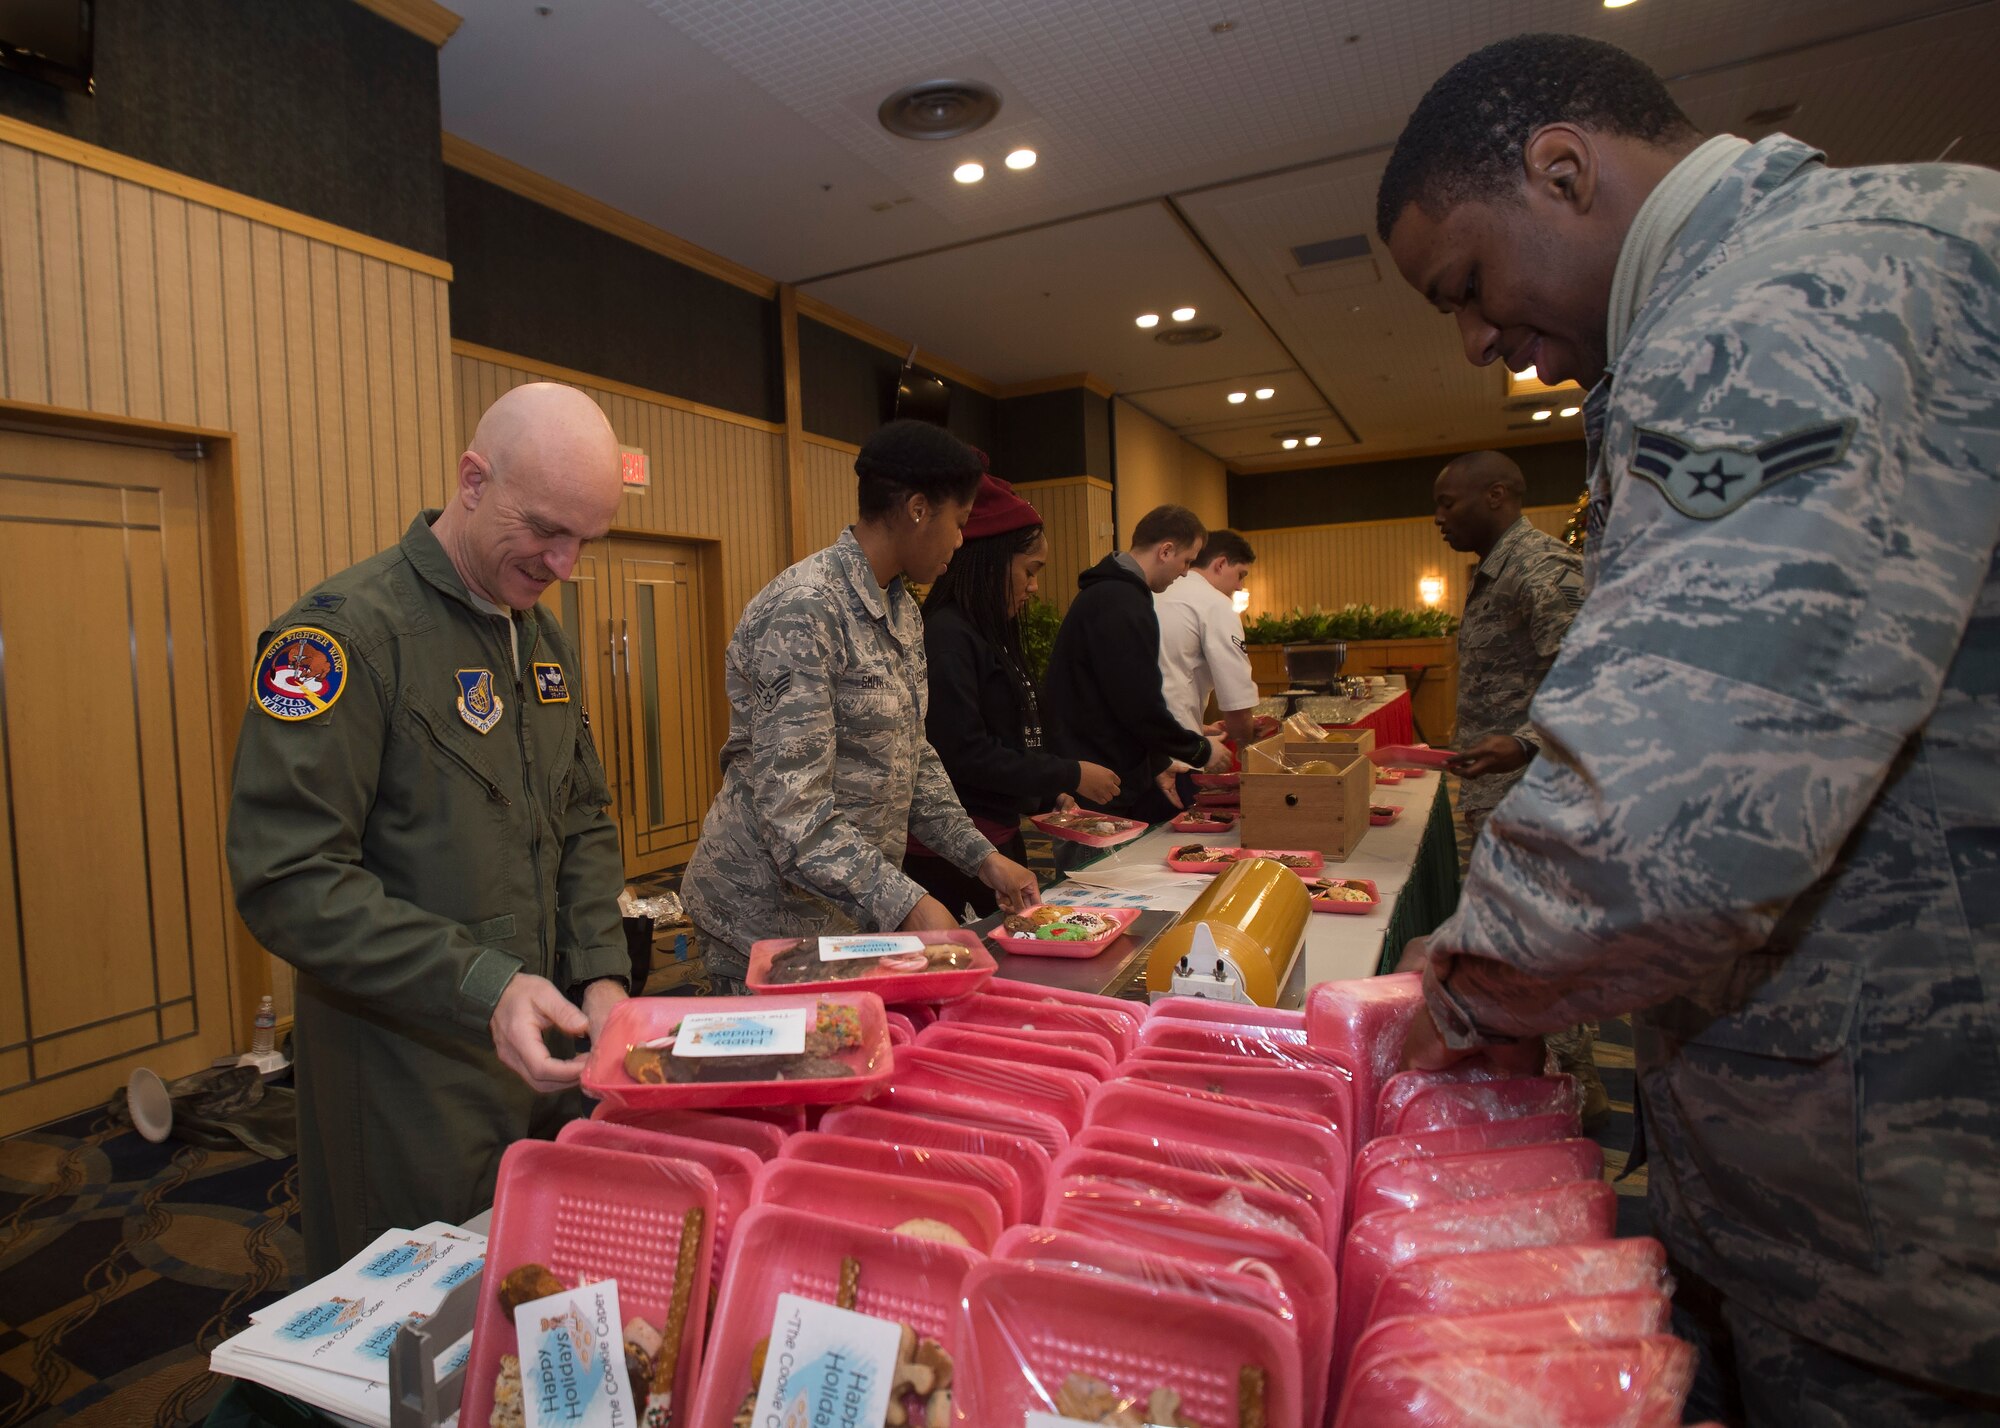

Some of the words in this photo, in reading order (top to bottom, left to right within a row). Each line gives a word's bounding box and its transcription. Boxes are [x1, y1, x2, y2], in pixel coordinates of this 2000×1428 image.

[622, 453, 645, 481] EXIT
[287, 632, 329, 647] FIGHTER
[328, 645, 343, 673] WING
[861, 674, 884, 689] SMITH
[261, 695, 320, 717] WEASEL
[272, 693, 307, 707] WILD
[706, 1028, 774, 1039] Holidays
[713, 1037, 765, 1047] Happy
[367, 1248, 399, 1272] Happy
[377, 1244, 419, 1278] Holidays
[412, 1259, 437, 1278] Cookie
[442, 1261, 474, 1285] Happy
[285, 1306, 323, 1332] Happy
[295, 1304, 344, 1340] Holidays
[333, 1318, 363, 1340] Cookie
[596, 1293, 609, 1337] Caper
[538, 1350, 560, 1413] Happy
[557, 1332, 583, 1420] Holidays
[600, 1341, 619, 1395] Cookie
[773, 1353, 794, 1411] Cookie
[814, 1350, 846, 1428] Holida
[841, 1370, 868, 1428] Happ
